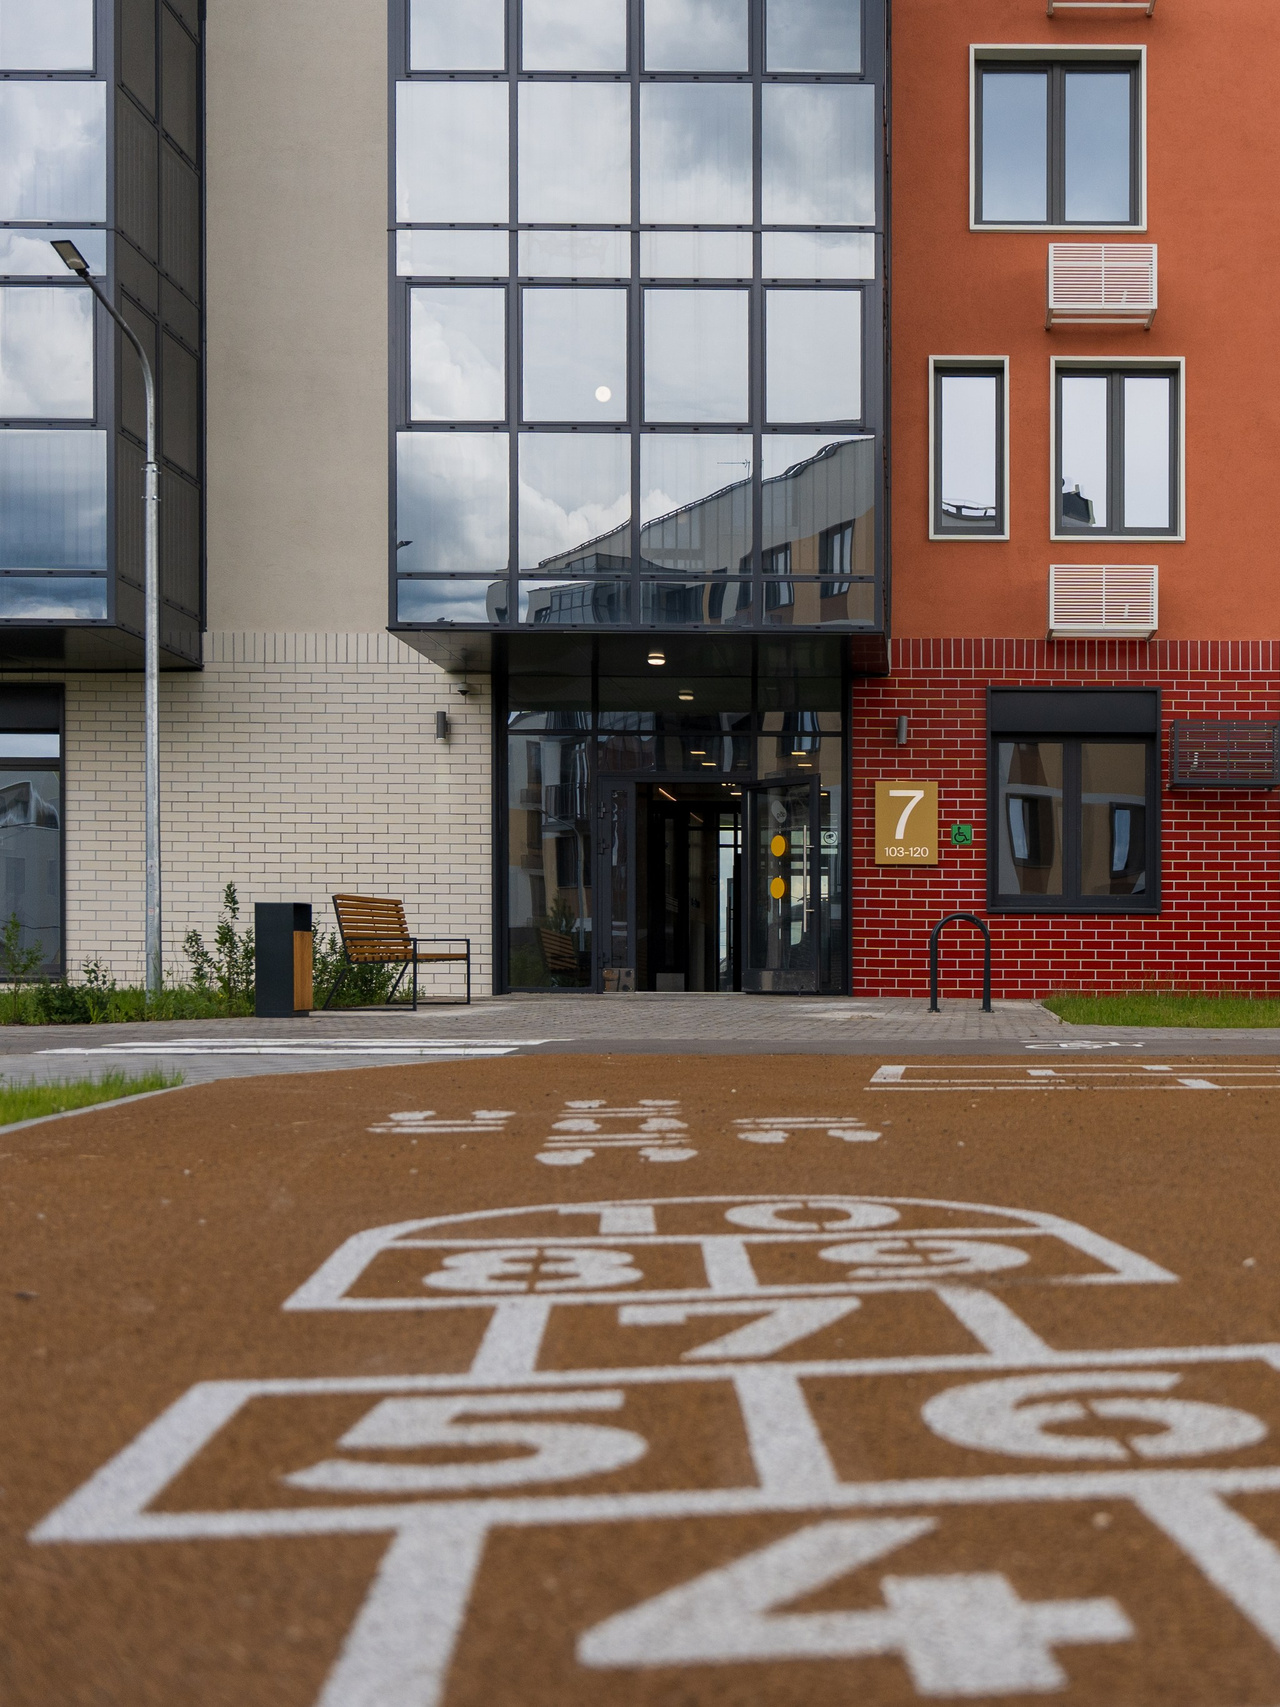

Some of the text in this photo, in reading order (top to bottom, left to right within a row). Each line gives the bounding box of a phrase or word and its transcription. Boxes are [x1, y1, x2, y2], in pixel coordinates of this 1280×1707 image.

[889, 789, 925, 840] 7
[884, 846, 929, 857] 103-120
[423, 1247, 643, 1292] 8
[818, 1238, 1030, 1279] 9
[618, 1296, 861, 1360] 7
[284, 1389, 647, 1492] 5
[920, 1371, 1267, 1460] 6
[578, 1516, 1133, 1695] 4
